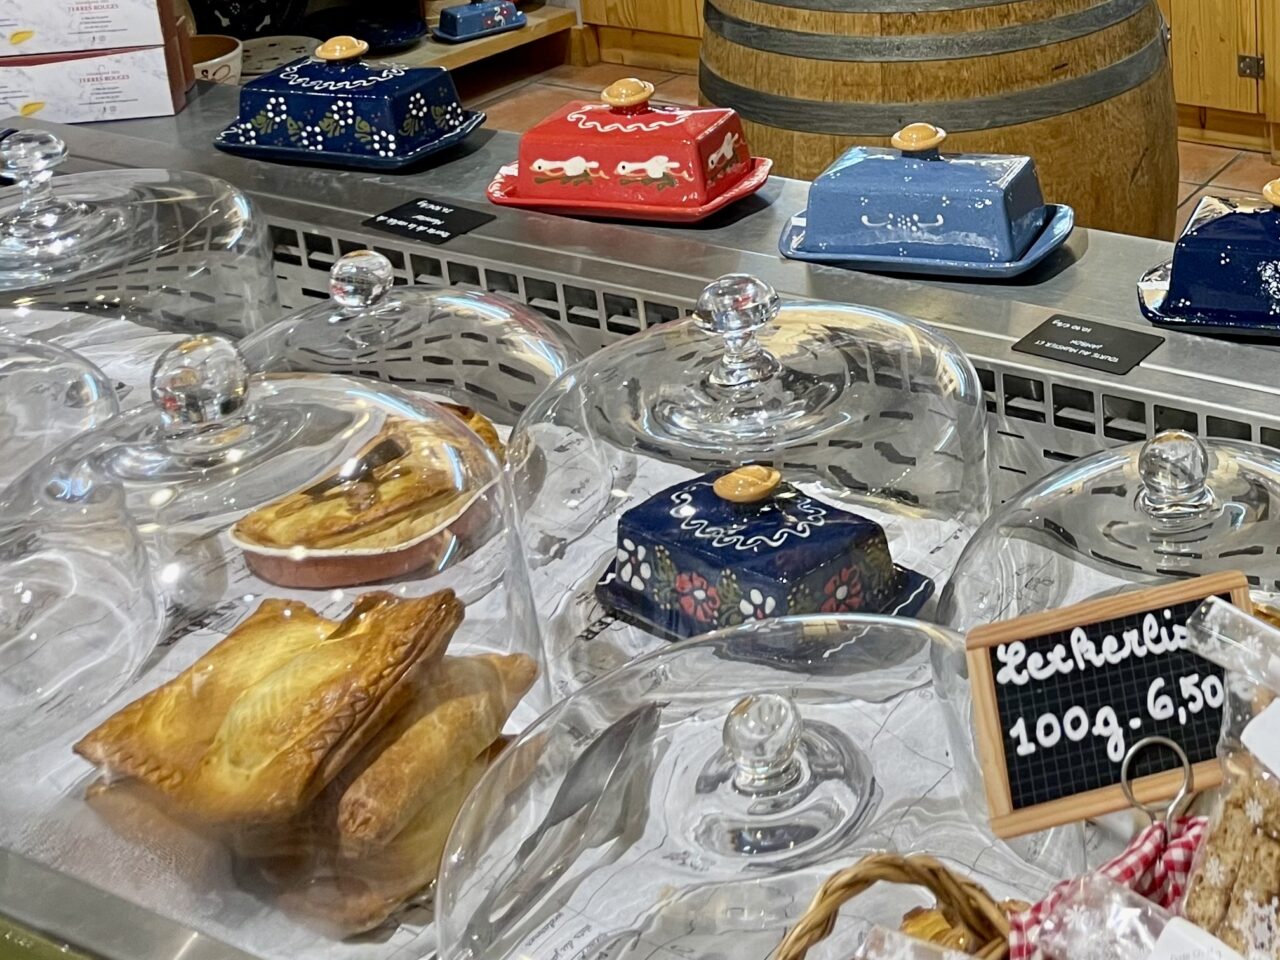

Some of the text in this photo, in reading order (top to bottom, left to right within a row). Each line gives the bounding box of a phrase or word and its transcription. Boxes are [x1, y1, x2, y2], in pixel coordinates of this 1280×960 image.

[93, 2, 119, 11] ROUGES
[104, 73, 130, 82] ROUGES
[1044, 342, 1079, 354] MUNSTER
[1069, 339, 1103, 349] JAMBON
[1090, 352, 1119, 363] TOURTE
[1010, 705, 1126, 763] 100g
[1146, 673, 1225, 725] 6,50
